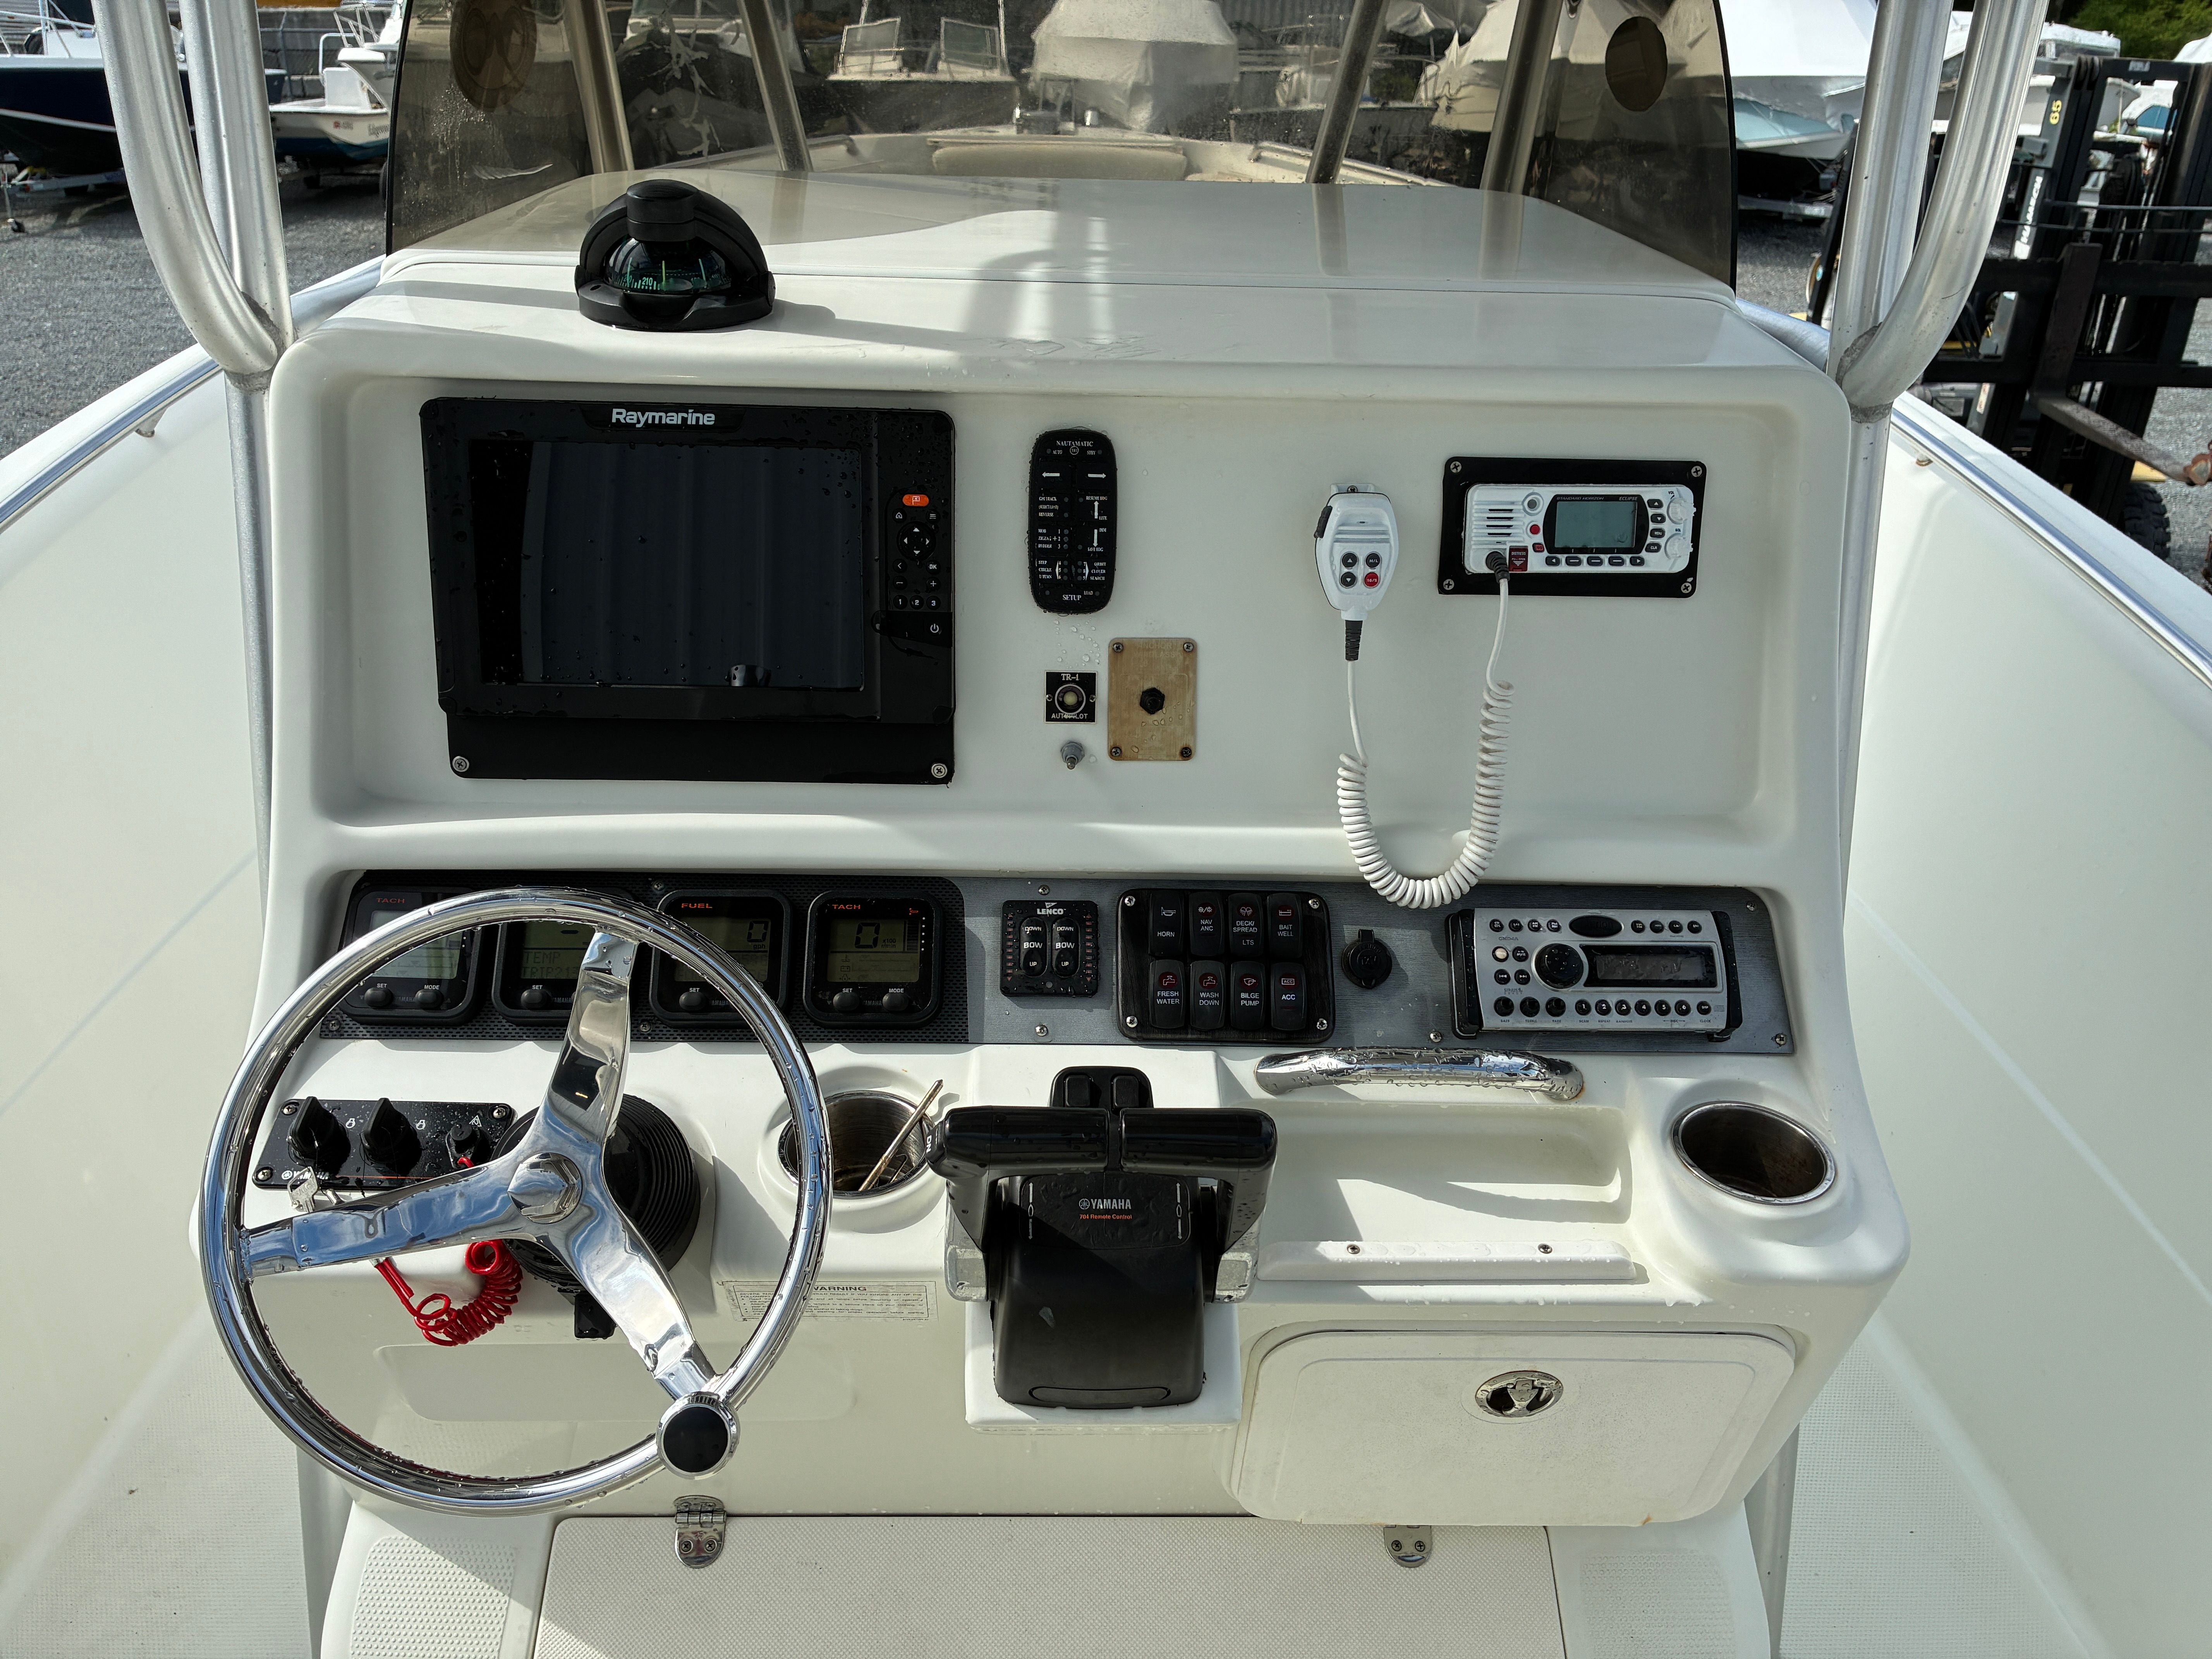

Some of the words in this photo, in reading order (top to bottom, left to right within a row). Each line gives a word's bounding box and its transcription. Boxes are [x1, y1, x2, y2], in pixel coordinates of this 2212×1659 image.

[2049, 100, 2062, 124] 65
[642, 276, 653, 286] 210
[612, 408, 715, 428] Raymarine
[747, 920, 769, 943] 0
[854, 922, 881, 949] 0
[523, 951, 560, 964] TEMP
[1091, 1199, 1132, 1209] YAMAHA
